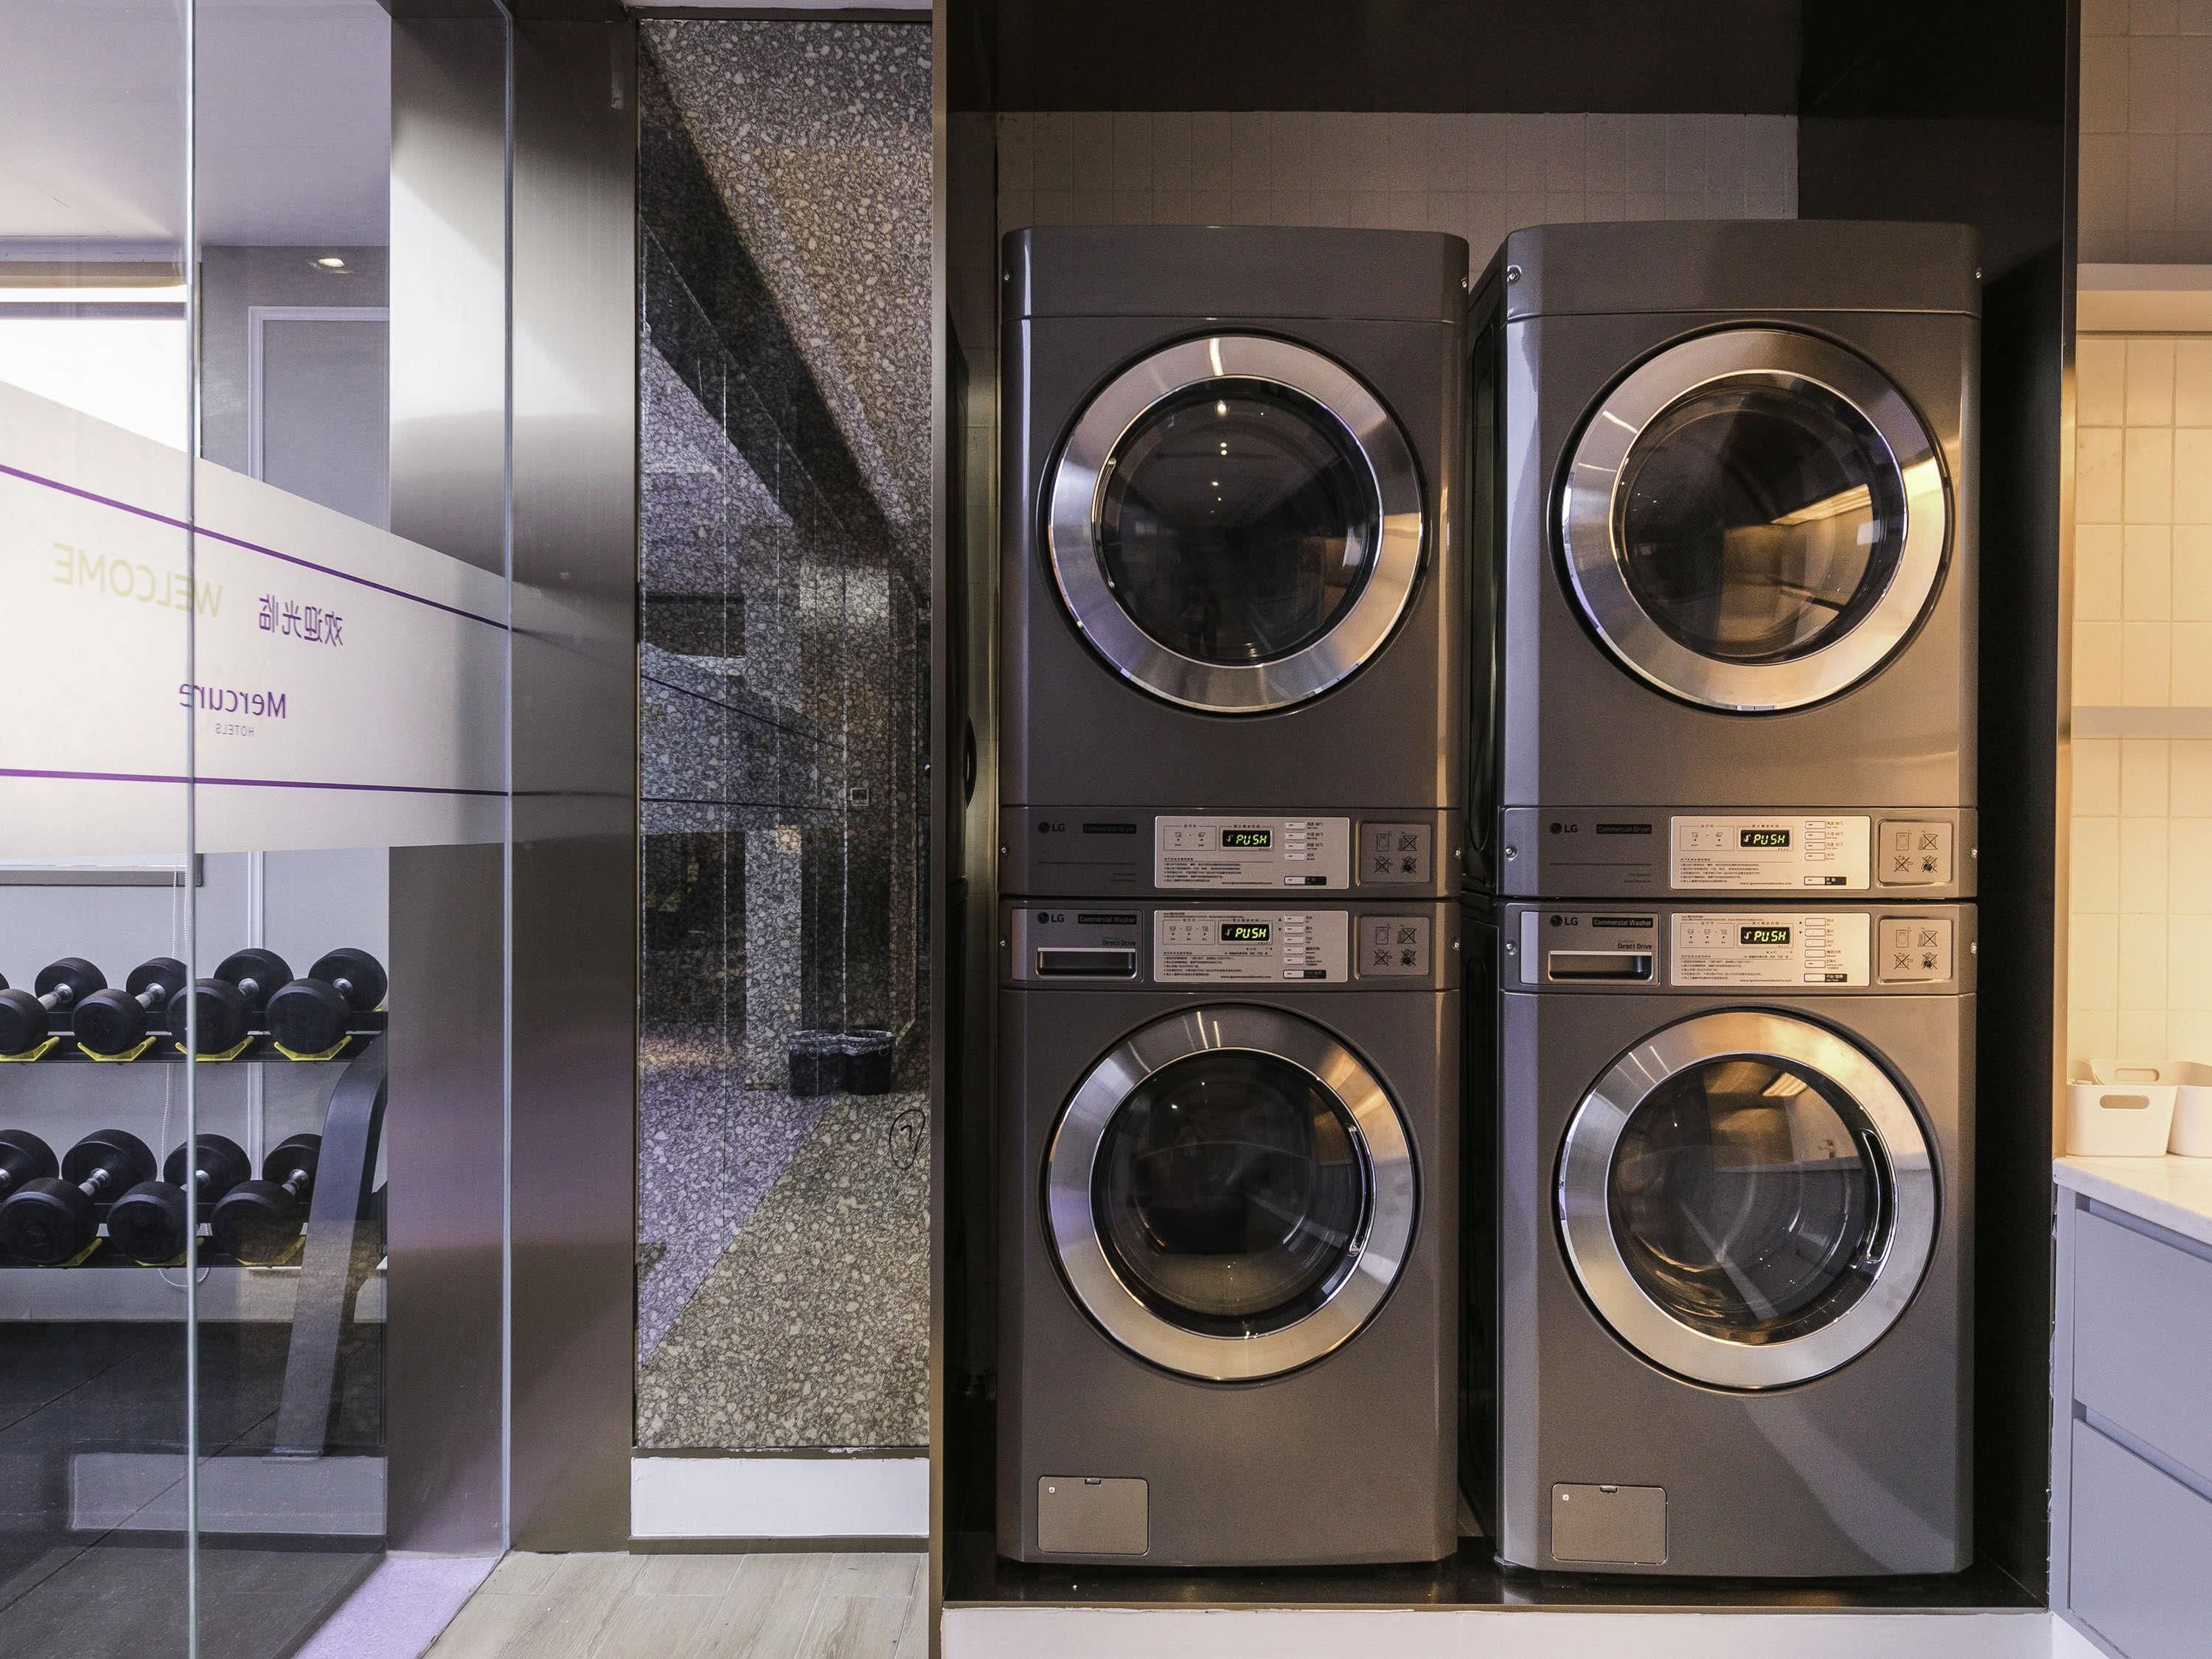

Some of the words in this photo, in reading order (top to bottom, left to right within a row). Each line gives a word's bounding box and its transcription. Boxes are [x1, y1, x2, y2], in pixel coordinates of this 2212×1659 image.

[1051, 823, 1065, 832] LG
[1565, 824, 1578, 833] LG
[1236, 834, 1267, 846] PUSH
[1753, 834, 1786, 845] PUSH
[1051, 914, 1065, 922] LG
[1565, 917, 1578, 926] LG
[1235, 928, 1267, 939] PUSH
[1753, 931, 1787, 942] PUSH
